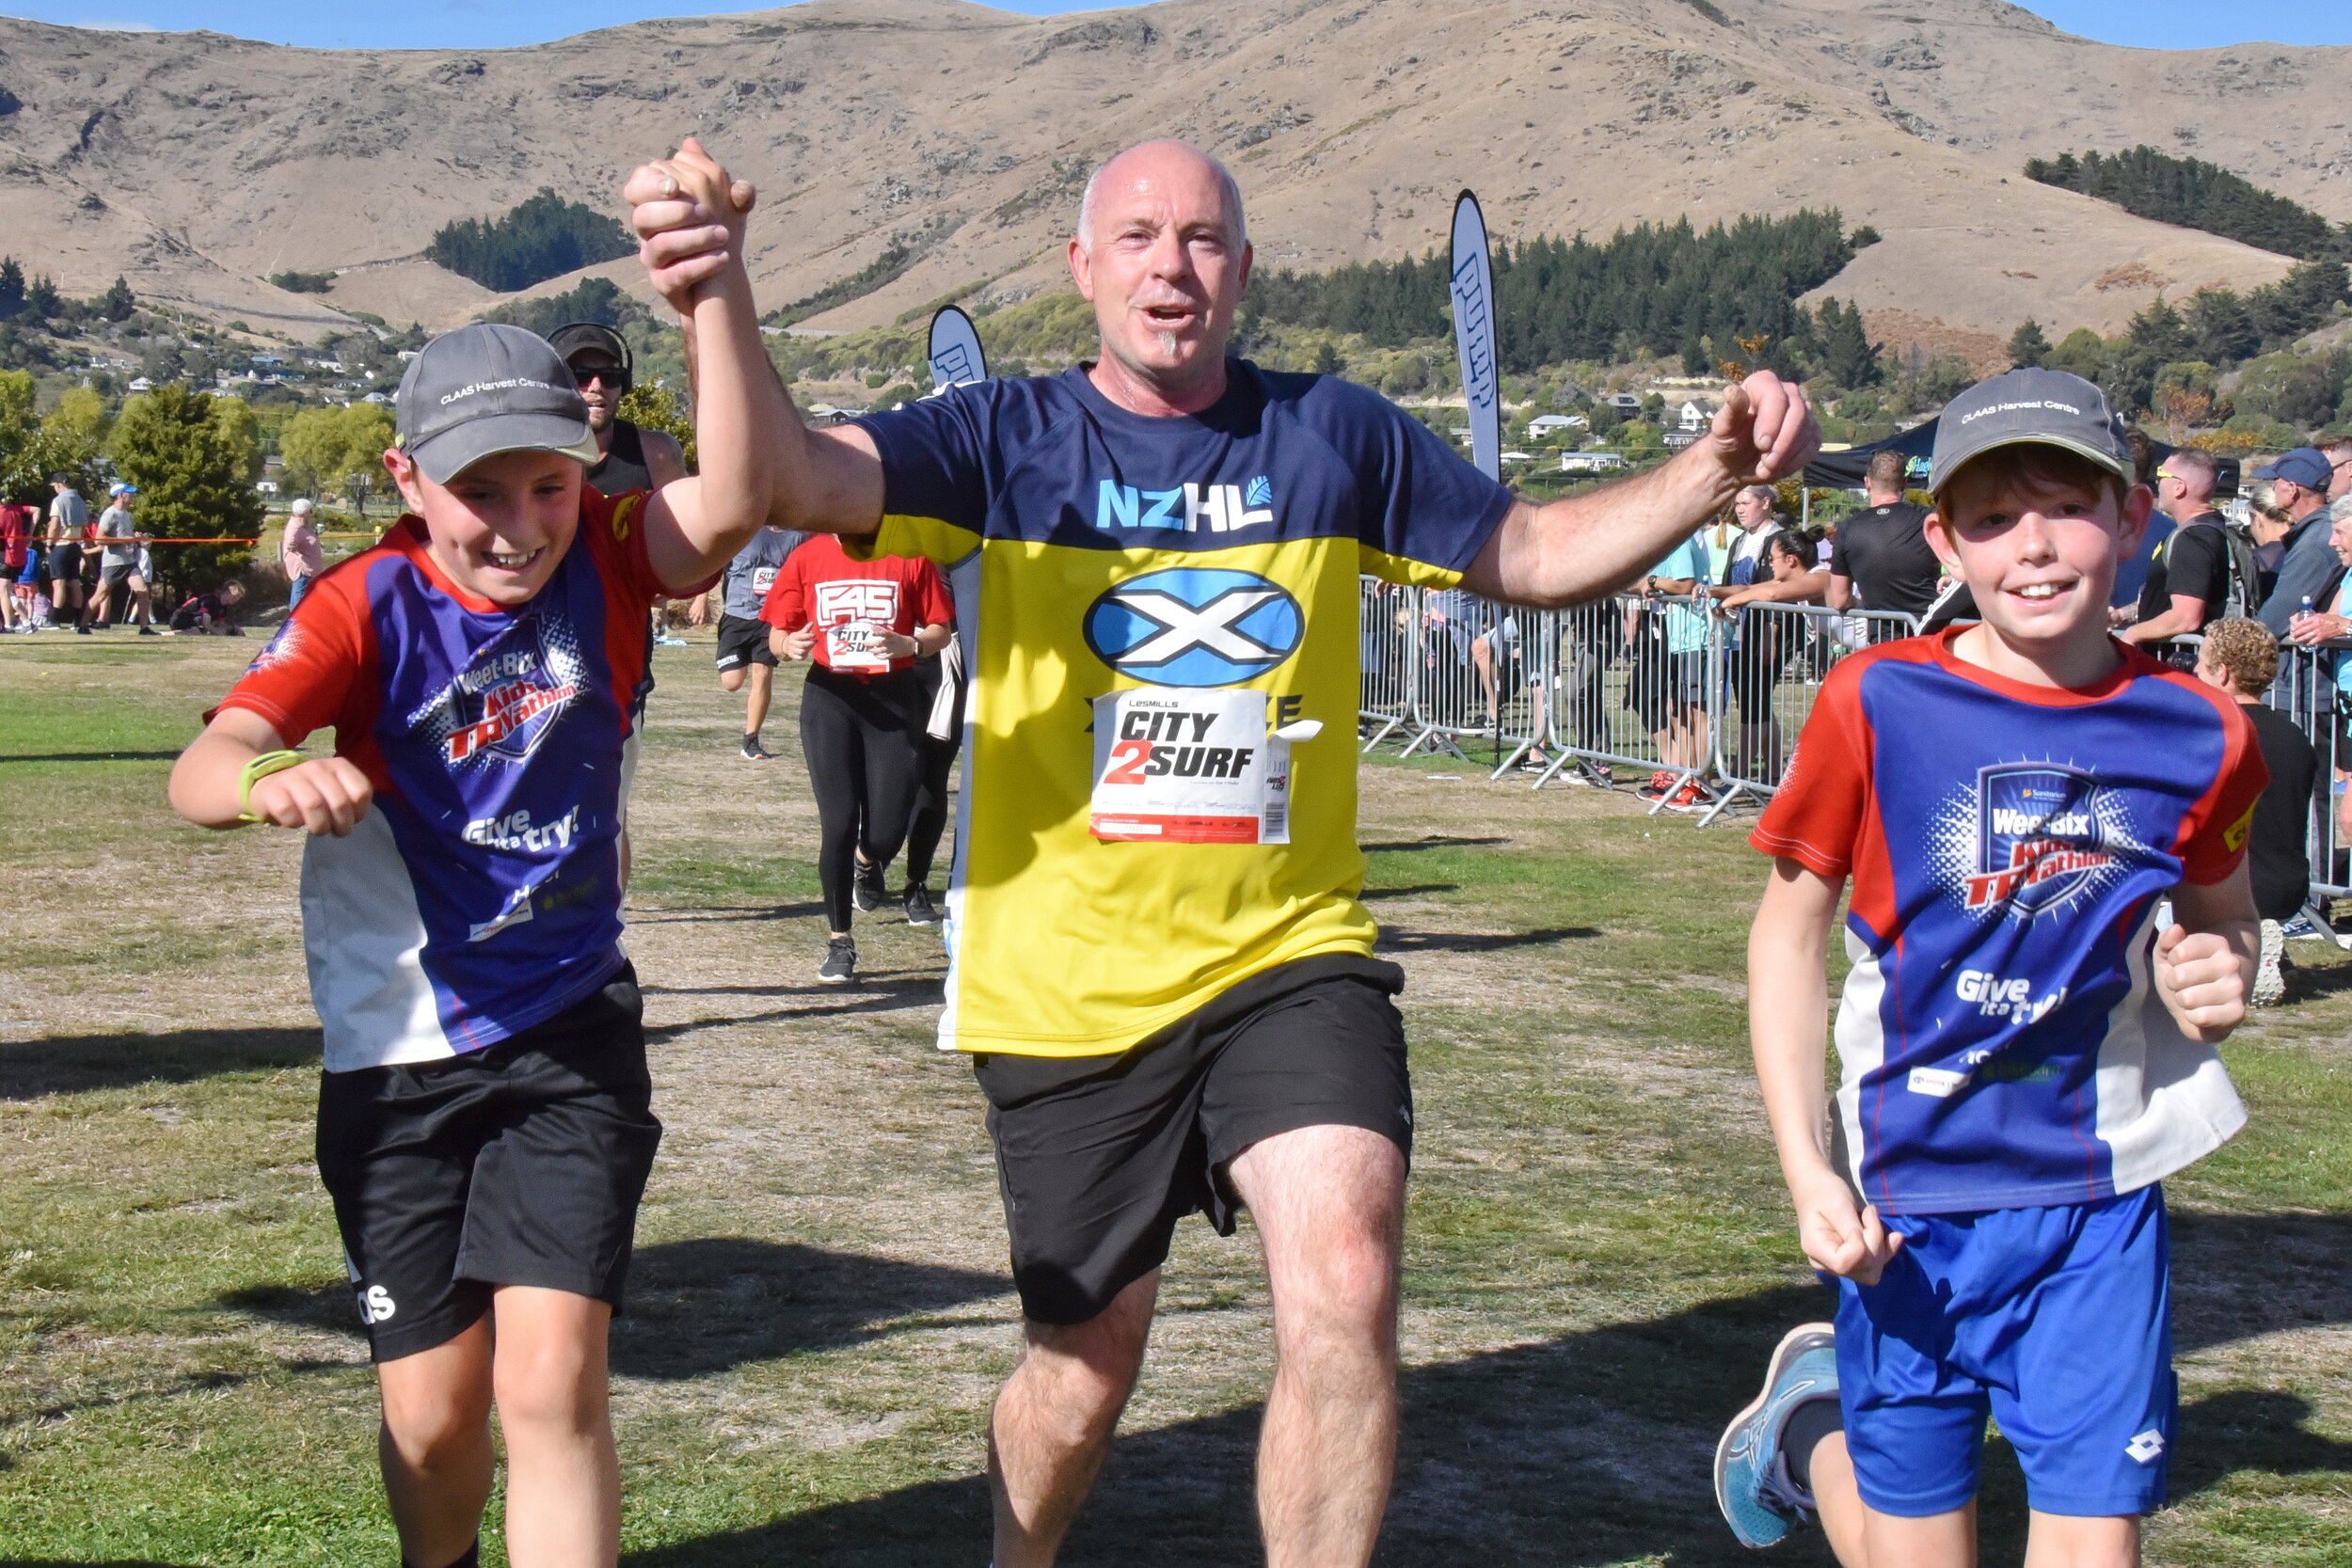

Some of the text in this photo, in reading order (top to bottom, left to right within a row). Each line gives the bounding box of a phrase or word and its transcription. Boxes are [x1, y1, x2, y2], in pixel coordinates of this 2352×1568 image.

[440, 377, 550, 404] CLAAS Harvest Centre
[1962, 401, 2080, 424] CLAAS Harvest Centre
[1096, 479, 1273, 532] NZHL
[820, 584, 895, 621] F45
[836, 631, 870, 641] CITY
[459, 651, 537, 695] Weet-Bix
[484, 680, 538, 719] Kids
[445, 685, 578, 763] TRYathlon
[1120, 710, 1219, 742] CITY
[461, 809, 531, 846] Give
[522, 804, 580, 852] try!
[1956, 969, 2030, 1003] Give
